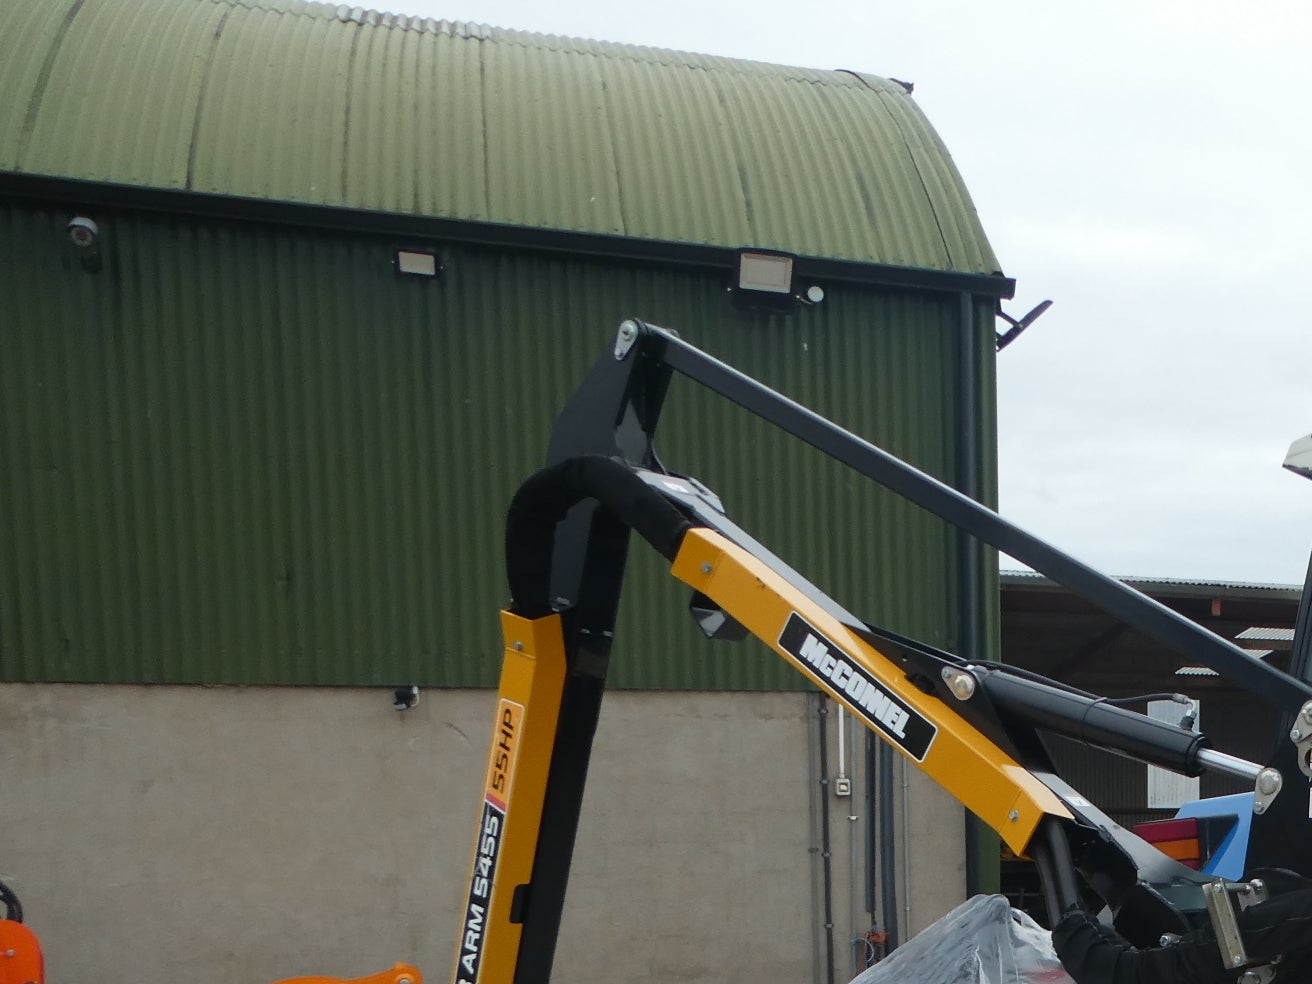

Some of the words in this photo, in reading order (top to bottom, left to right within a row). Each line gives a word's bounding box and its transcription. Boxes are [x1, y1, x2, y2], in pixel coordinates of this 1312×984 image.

[492, 708, 514, 794] 55HP
[473, 816, 499, 898] 5455
[462, 903, 485, 975] ARM
